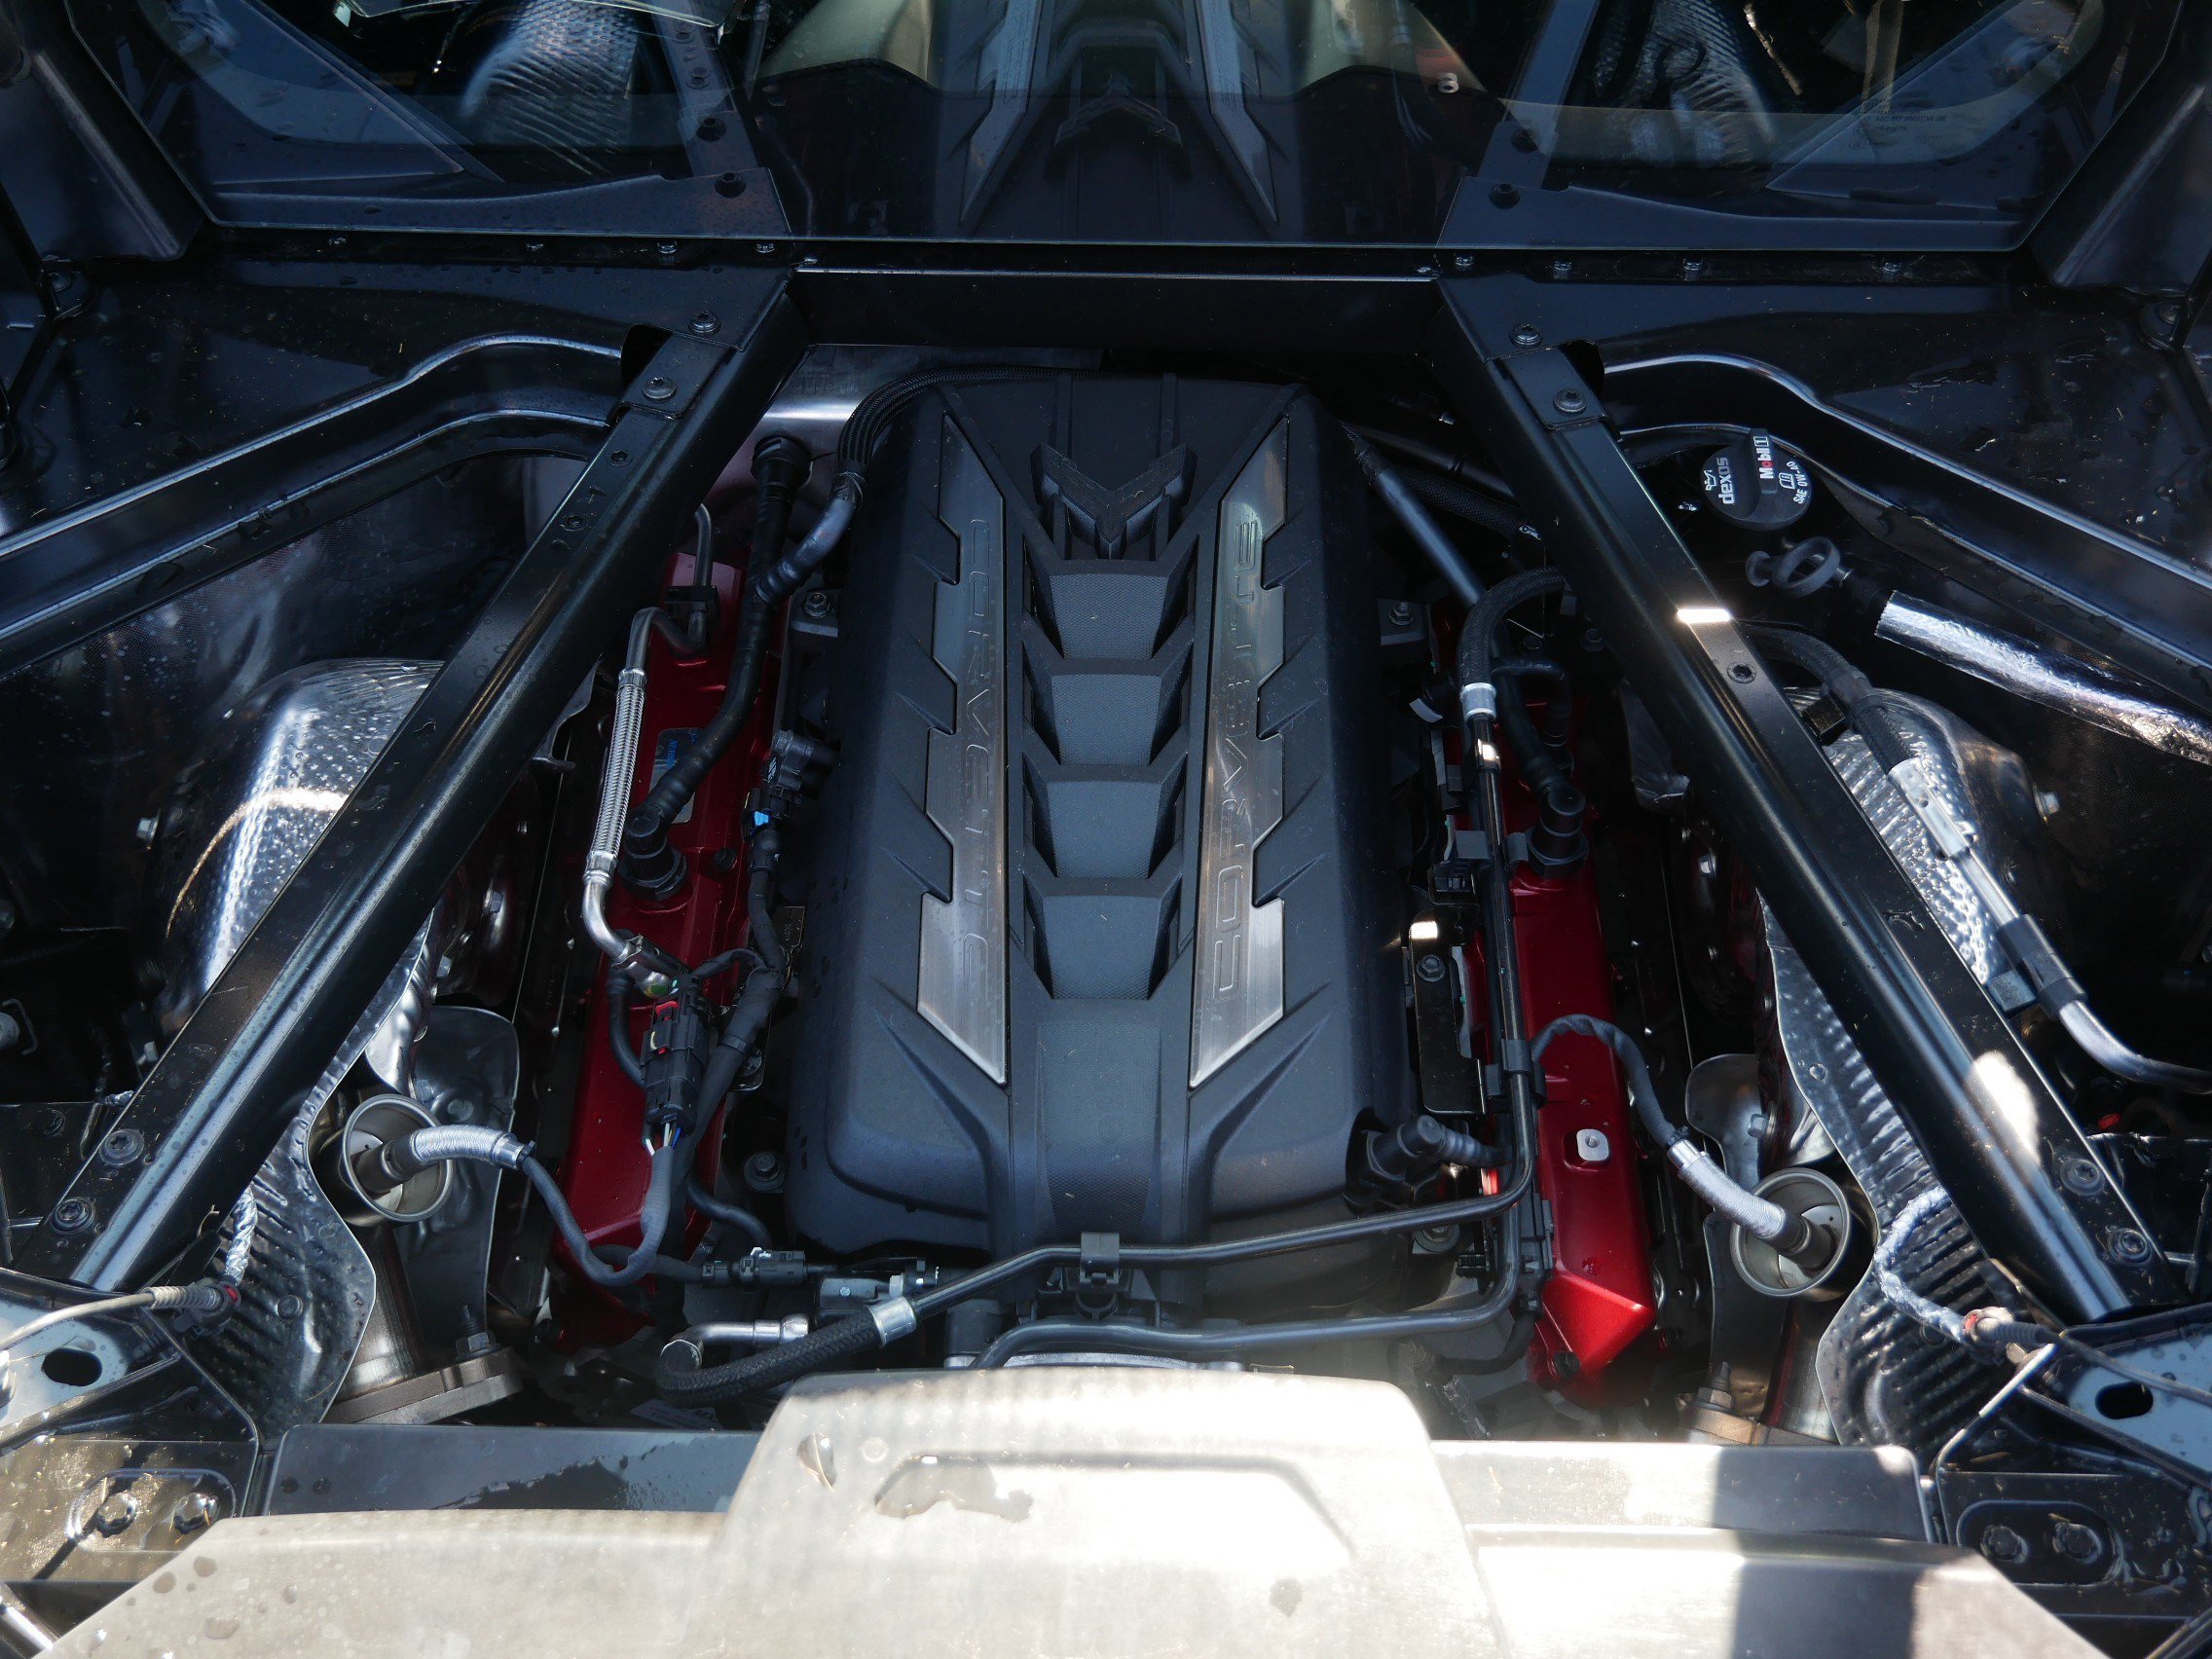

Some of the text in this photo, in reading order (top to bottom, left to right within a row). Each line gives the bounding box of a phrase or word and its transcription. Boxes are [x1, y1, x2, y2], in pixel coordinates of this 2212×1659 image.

[1716, 457, 1734, 504] dexos
[1756, 448, 1774, 479] Mobil
[1786, 461, 1808, 503] SAE 0W-40
[965, 519, 990, 993] CORVETTE
[1213, 520, 1256, 1001] CORVETTE
